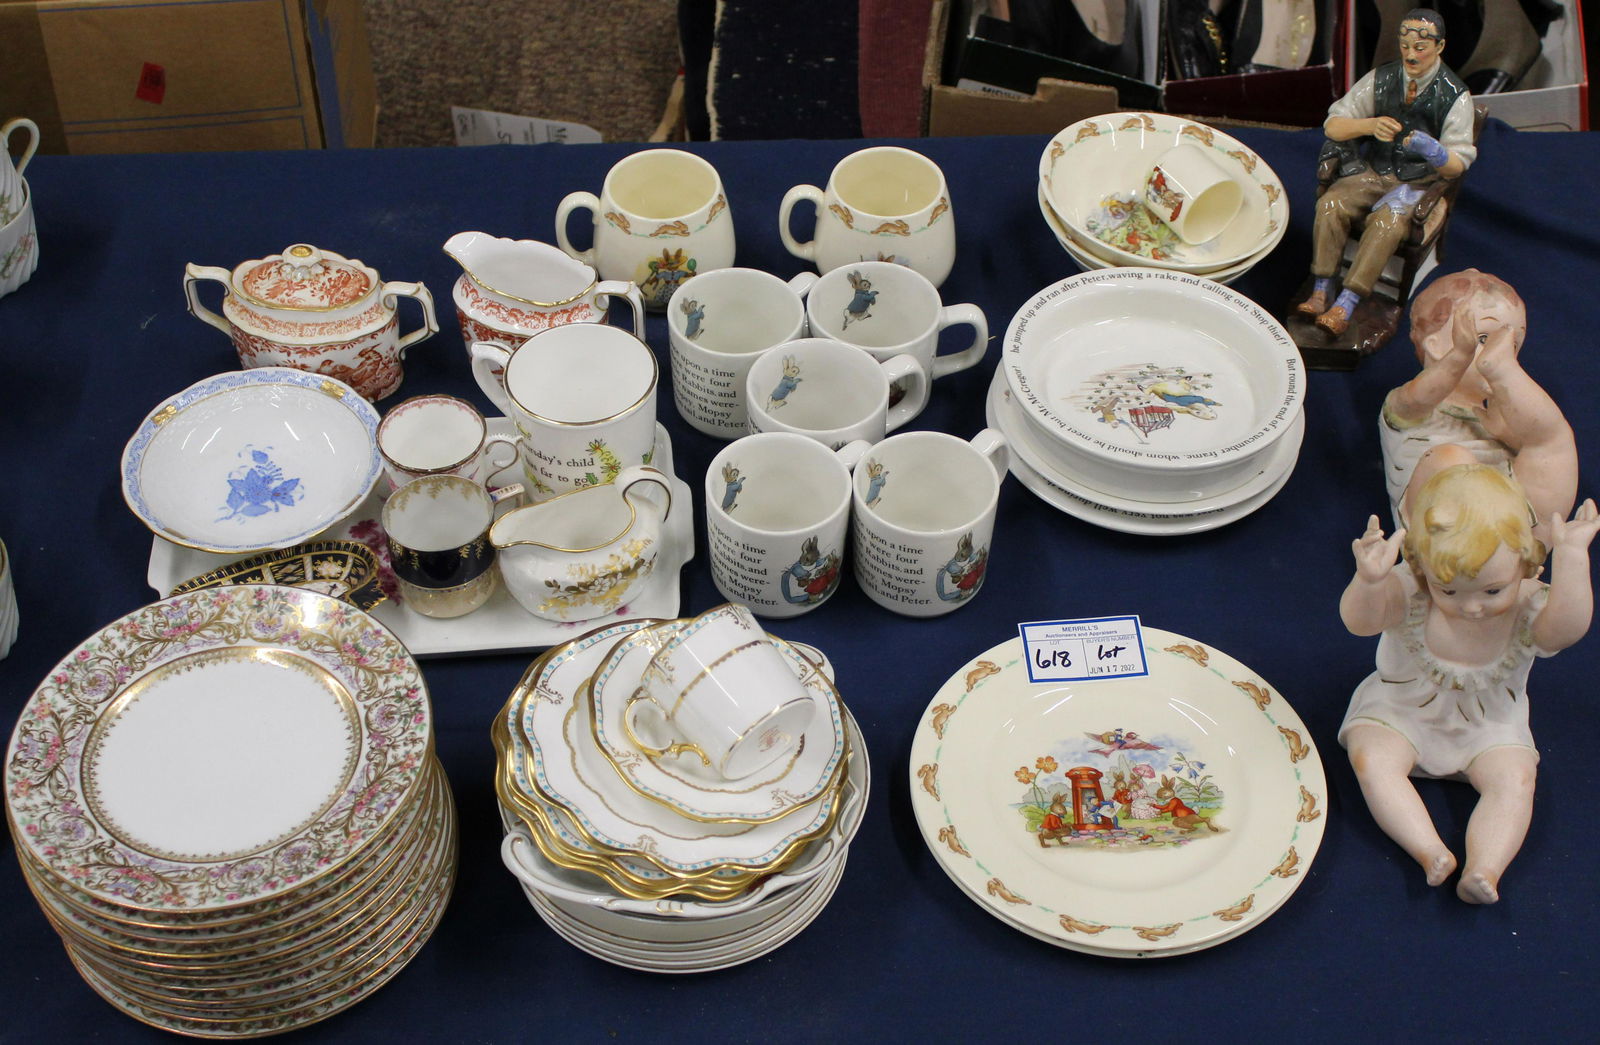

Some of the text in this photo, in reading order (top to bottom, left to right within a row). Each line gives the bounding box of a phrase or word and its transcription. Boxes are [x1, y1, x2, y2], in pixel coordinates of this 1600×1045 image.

[1155, 272, 1178, 281] rake
[1180, 276, 1200, 286] and
[1046, 290, 1060, 300] ran
[1060, 282, 1080, 292] after
[1202, 282, 1234, 301] calling
[1034, 296, 1048, 310] and
[1026, 309, 1036, 320] up
[1010, 317, 1028, 344] jumped
[1010, 342, 1020, 354] he
[680, 354, 701, 371] upon
[712, 369, 736, 378] time
[1286, 358, 1296, 373] But
[684, 367, 706, 382] were
[710, 378, 731, 388] four
[1288, 374, 1297, 394] round
[682, 384, 708, 404] names
[1284, 395, 1296, 406] the
[698, 404, 732, 420] Mopsy
[1276, 406, 1288, 420] end
[1050, 416, 1068, 428] but
[1269, 420, 1278, 430] of
[1066, 426, 1093, 442] meet
[1094, 440, 1106, 449] he
[1221, 432, 1265, 454] cucumber
[1108, 445, 1143, 458] should
[566, 458, 594, 468] child
[540, 467, 552, 478] far
[558, 474, 570, 483] to
[574, 478, 588, 486] go
[1094, 502, 1120, 514] well
[1121, 510, 1148, 519] very
[714, 523, 732, 542] upon
[742, 544, 766, 554] time
[866, 528, 887, 546] upon
[899, 544, 924, 554] time
[717, 536, 762, 564] were four
[870, 541, 918, 564] were four
[714, 554, 739, 577] names
[864, 558, 893, 579] names
[728, 576, 762, 595] Mopsy
[881, 578, 916, 596] Mopsy
[1036, 648, 1072, 668] 618
[1090, 666, 1104, 674] JUN
[1120, 664, 1136, 672] 2022
